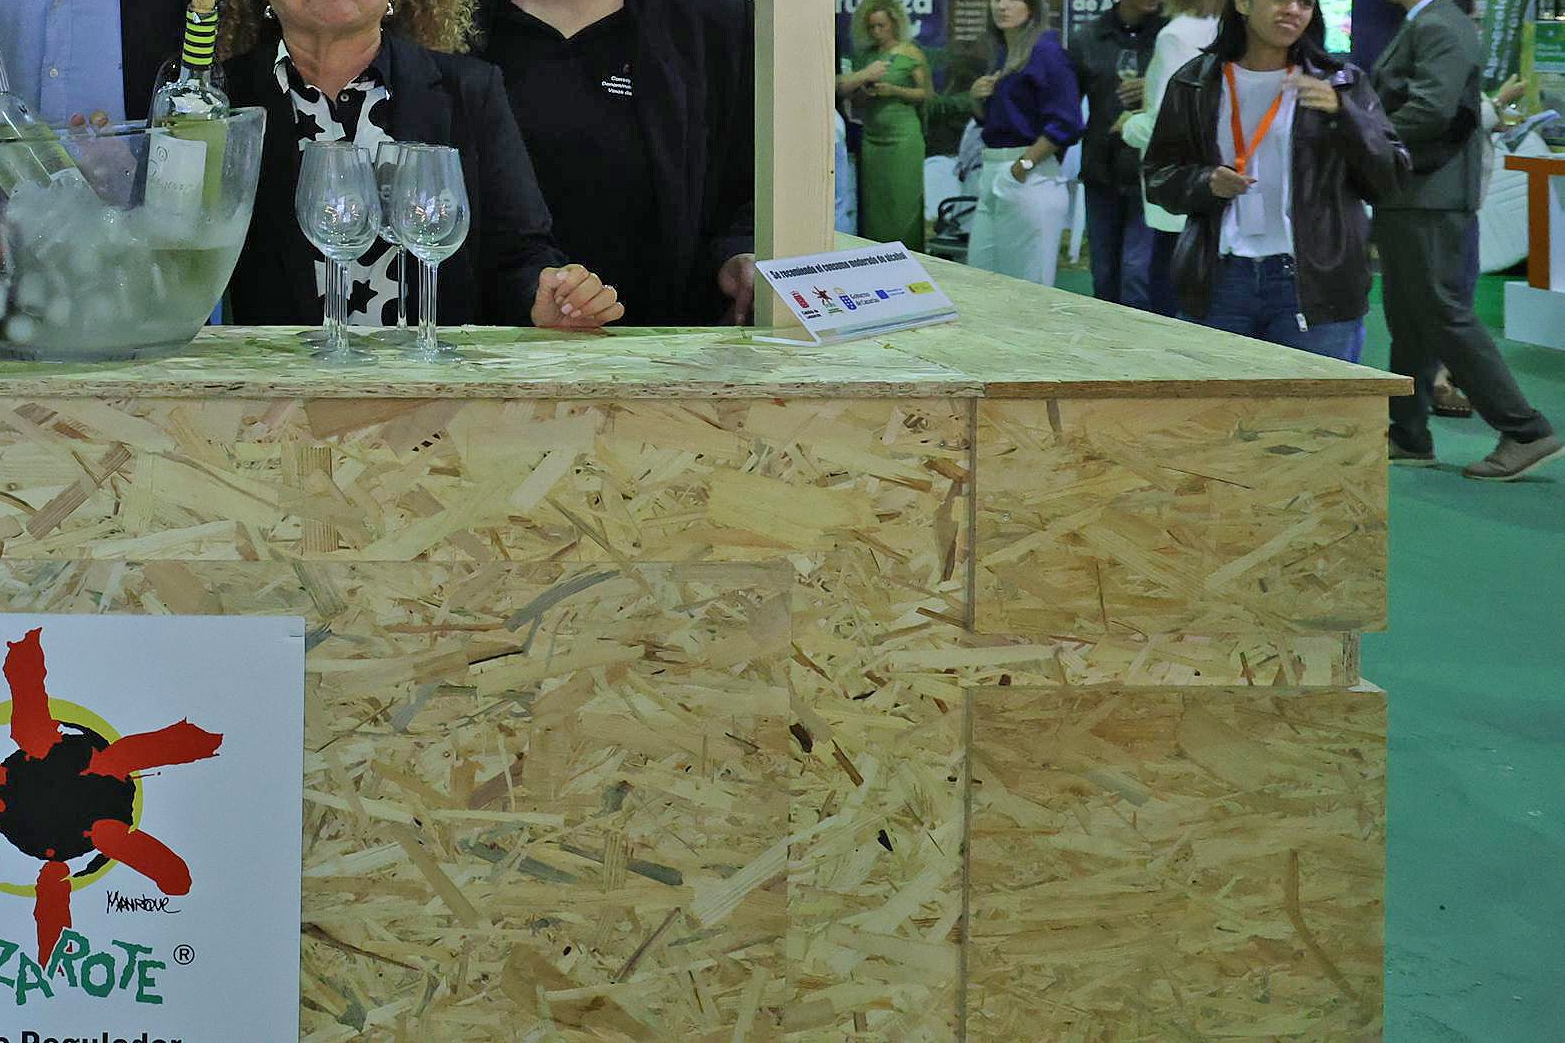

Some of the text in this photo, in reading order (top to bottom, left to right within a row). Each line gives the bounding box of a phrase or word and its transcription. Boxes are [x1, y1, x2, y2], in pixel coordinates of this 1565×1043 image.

[770, 270, 781, 279] Se
[780, 264, 818, 278] recomienda
[815, 263, 824, 273] el
[822, 261, 851, 272] consumo
[848, 255, 879, 268] moderado
[877, 255, 887, 264] de
